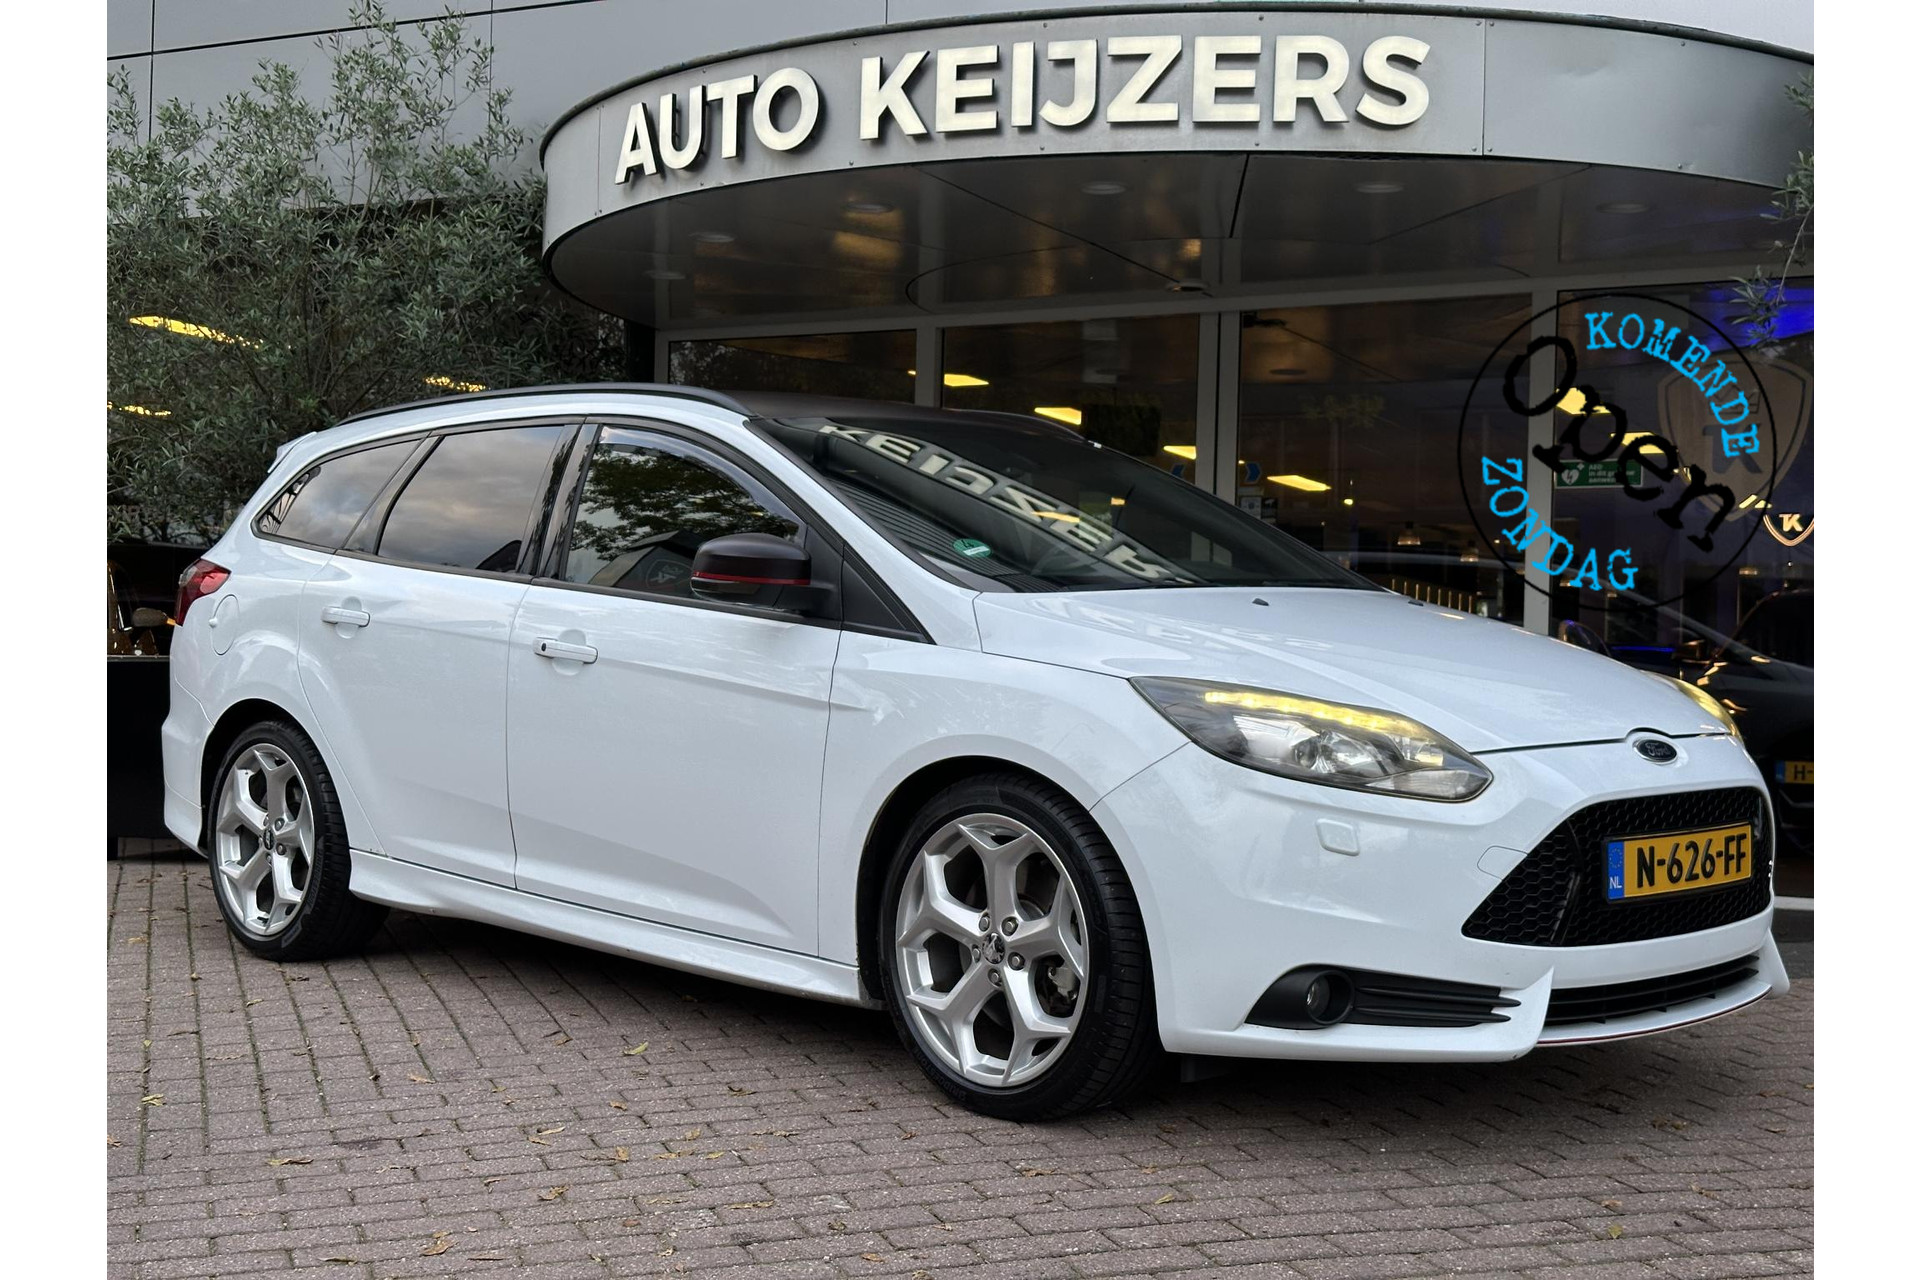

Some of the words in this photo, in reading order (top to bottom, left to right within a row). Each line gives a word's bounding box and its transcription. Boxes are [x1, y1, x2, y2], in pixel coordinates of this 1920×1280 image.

[615, 66, 819, 185] AUTO
[860, 34, 1431, 141] KEIJZERS
[1644, 742, 1672, 756] Ford
[1636, 833, 1747, 889] N-626-FF
[1609, 876, 1622, 889] NL
